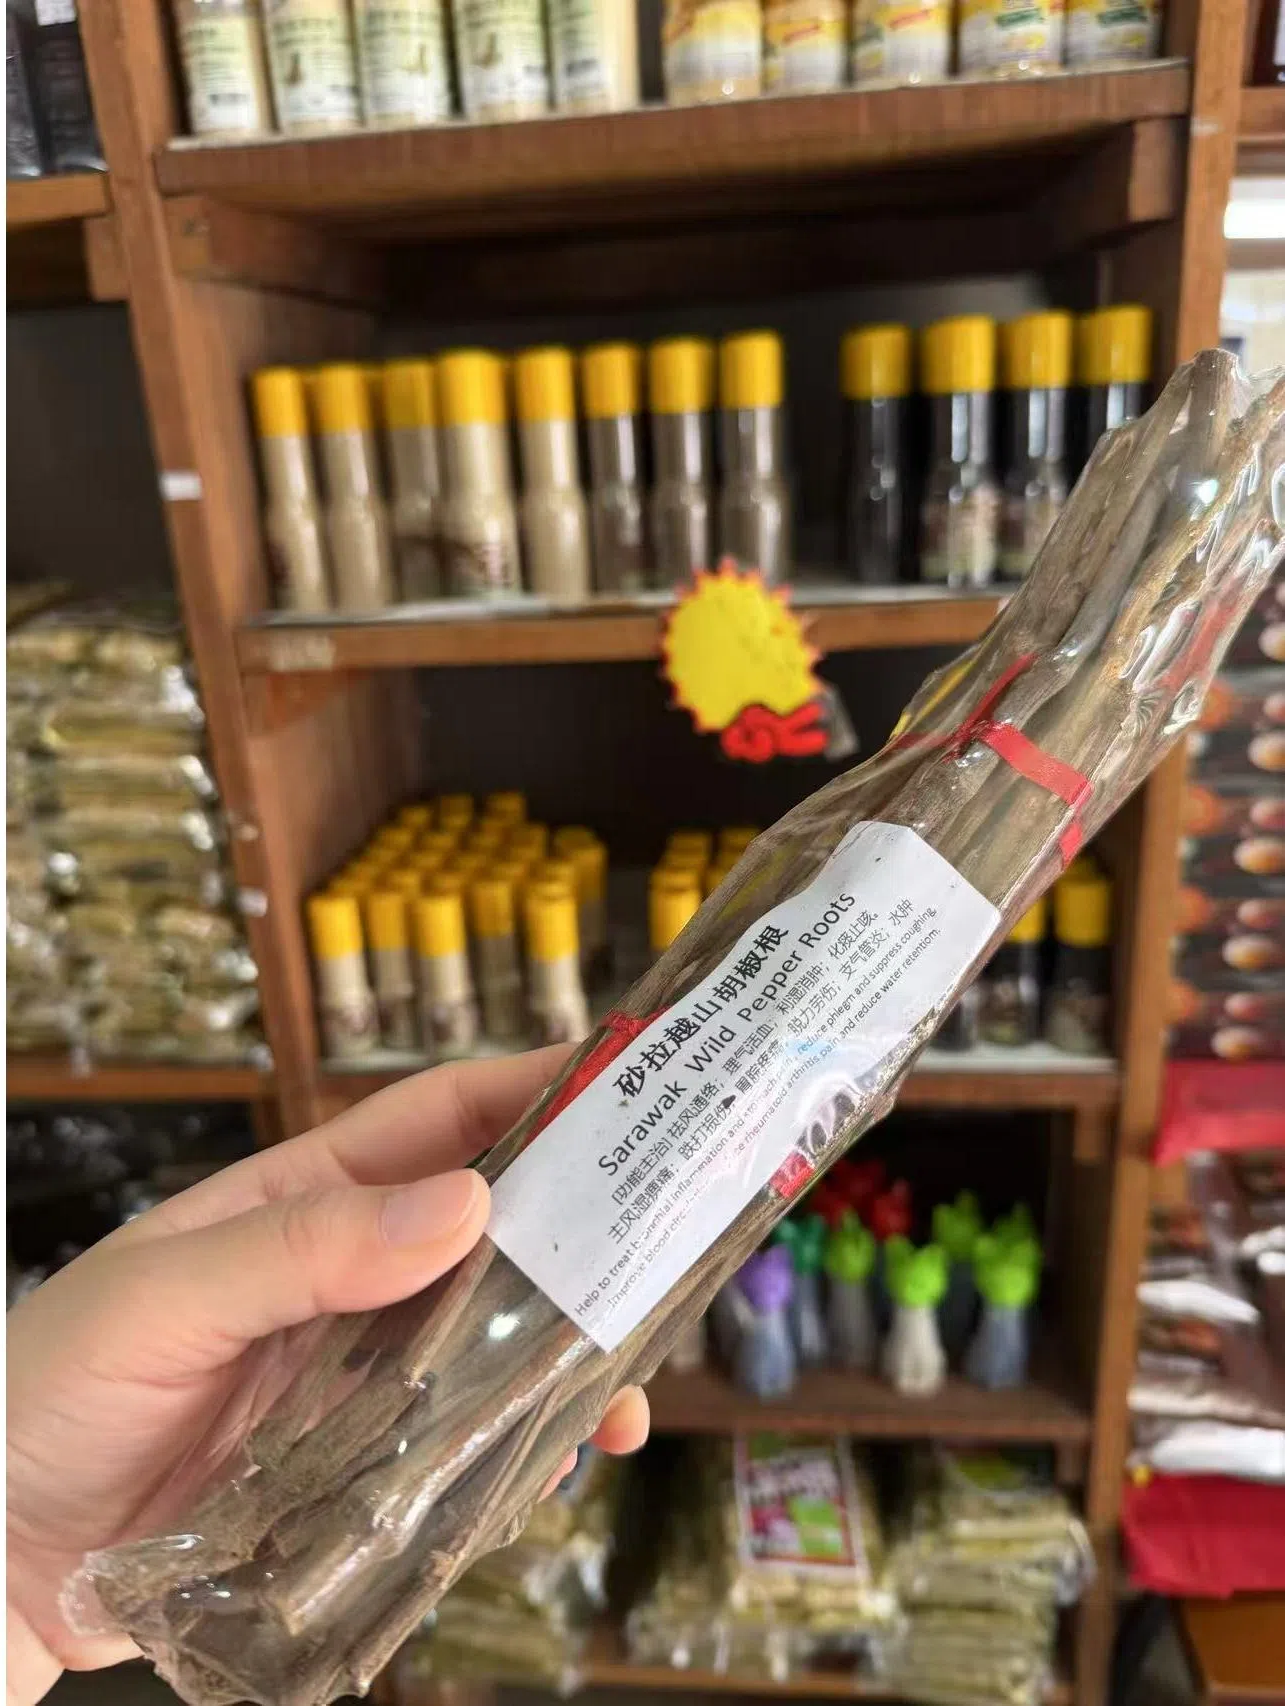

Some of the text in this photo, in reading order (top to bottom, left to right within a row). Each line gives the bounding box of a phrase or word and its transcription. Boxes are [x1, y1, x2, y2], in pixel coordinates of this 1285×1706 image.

[573, 1287, 599, 1316] Help
[596, 1274, 612, 1290] to
[609, 1247, 634, 1277] treat
[629, 1197, 672, 1250] bonchial
[669, 1136, 728, 1201] inflammation
[724, 1116, 746, 1138] and
[794, 1022, 829, 1055] reduce
[824, 993, 857, 1028] phlegm
[851, 974, 872, 996] and
[867, 941, 904, 980] suppress
[897, 903, 938, 946] coughing,
[596, 1079, 688, 1177] Sarawak
[683, 1023, 737, 1072] Wild
[736, 949, 803, 1021] Pepper
[797, 891, 856, 949] Roots
[611, 924, 790, 1098] 砂拉越山胡椒根
[643, 1229, 672, 1263] blood
[741, 1087, 789, 1144] rheumatoid
[785, 1053, 819, 1089] arthritis
[820, 1034, 841, 1059] pain
[836, 1017, 857, 1039] and
[851, 989, 883, 1022] reduce
[879, 966, 904, 993] water
